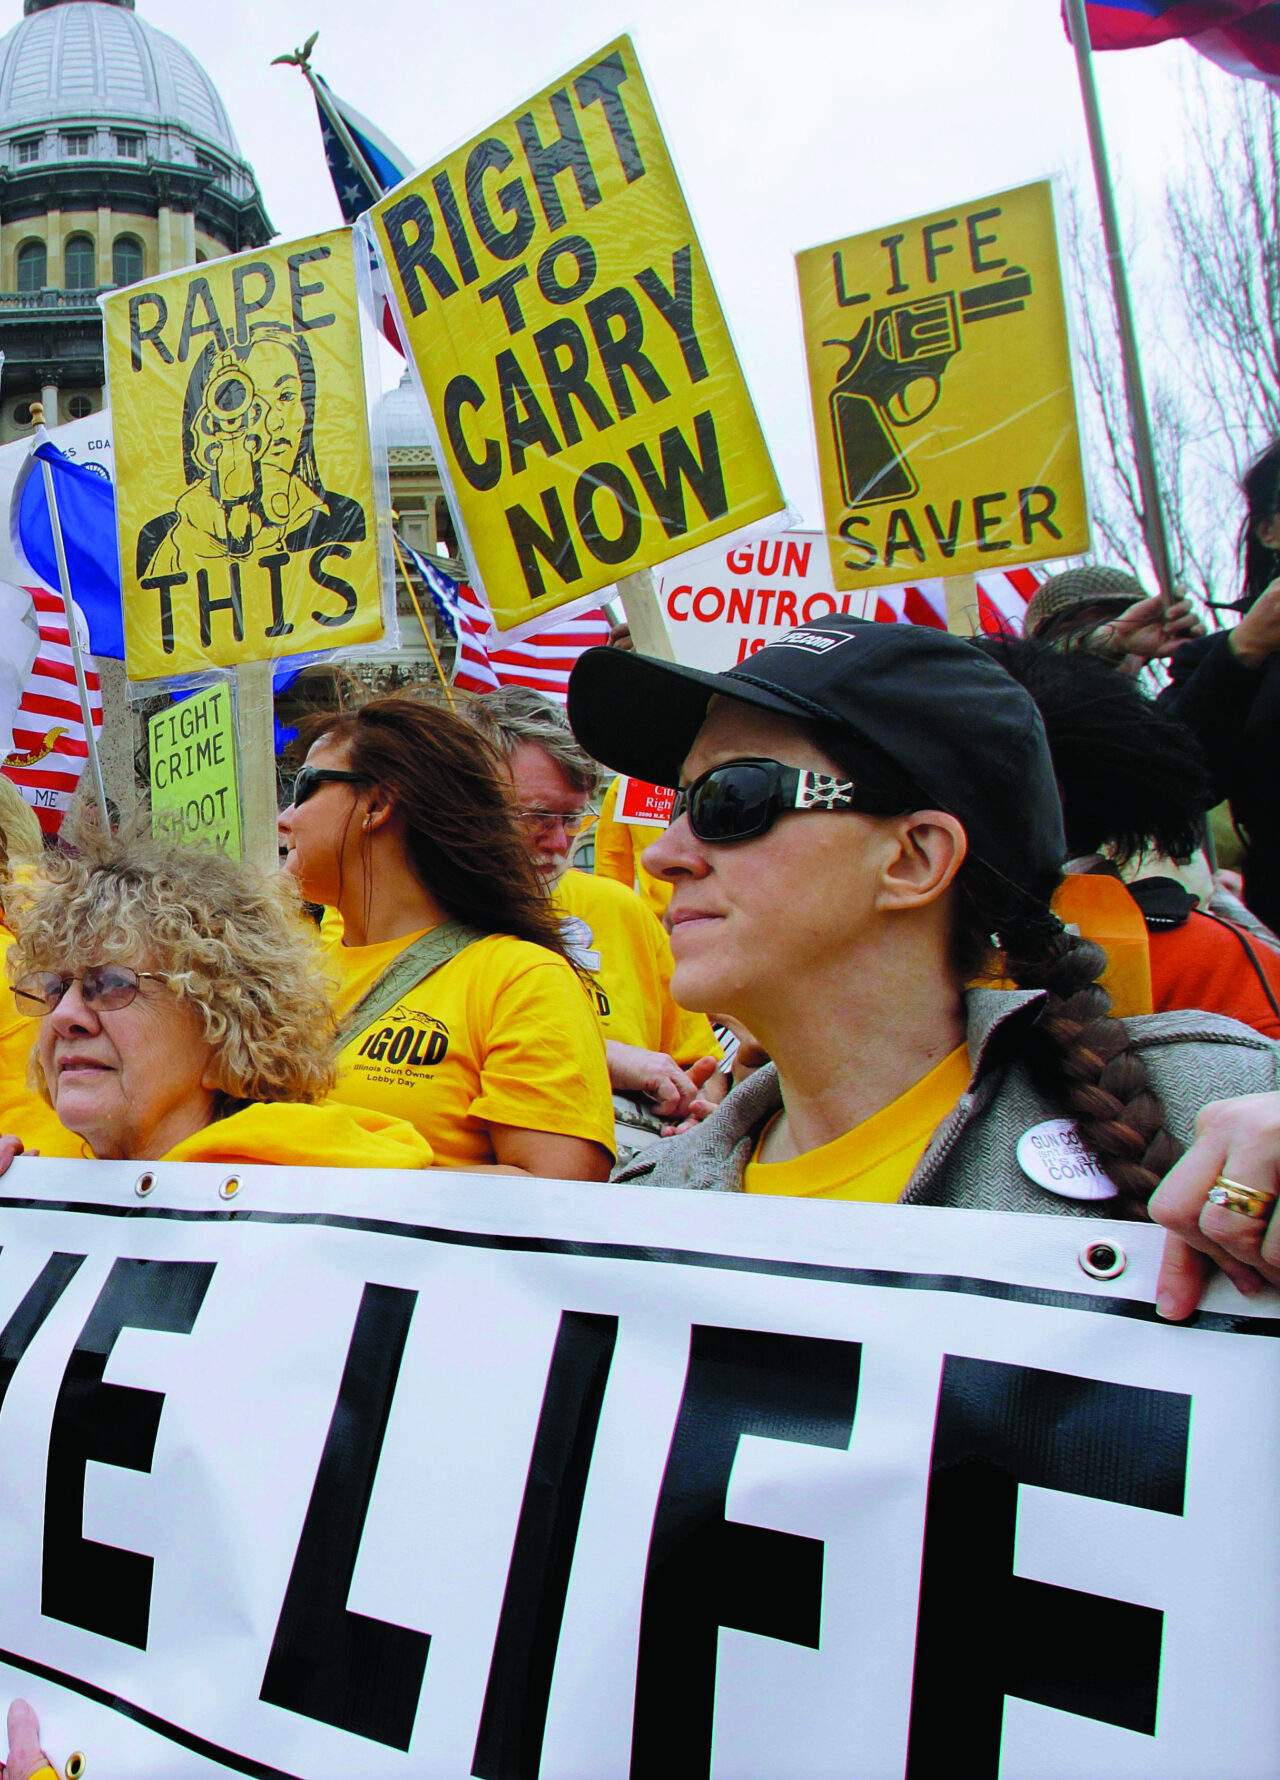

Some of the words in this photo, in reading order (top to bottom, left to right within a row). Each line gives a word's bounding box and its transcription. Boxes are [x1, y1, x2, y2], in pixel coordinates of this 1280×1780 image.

[380, 50, 648, 318] RIGHT
[479, 234, 597, 336] TO
[831, 206, 1007, 308] LIFE
[128, 246, 338, 373] RAPE
[442, 245, 711, 493] CARRY
[87, 439, 112, 451] COA
[503, 409, 730, 600] NOW
[839, 484, 1064, 573] SAVER
[726, 540, 813, 578] GUN
[139, 543, 360, 656] THIS
[153, 692, 222, 753] FIGHT
[154, 731, 226, 790] CRIME
[34, 789, 59, 808] ME
[645, 796, 672, 812] Righ
[353, 1064, 381, 1073] Illinois
[384, 1066, 403, 1075] Gun
[405, 1069, 434, 1080] Owner
[358, 1026, 449, 1066] IGOLD
[367, 1074, 395, 1085] Lobby
[398, 1078, 416, 1088] Day
[1031, 1133, 1060, 1149] GUN
[1048, 1161, 1106, 1180] CONT
